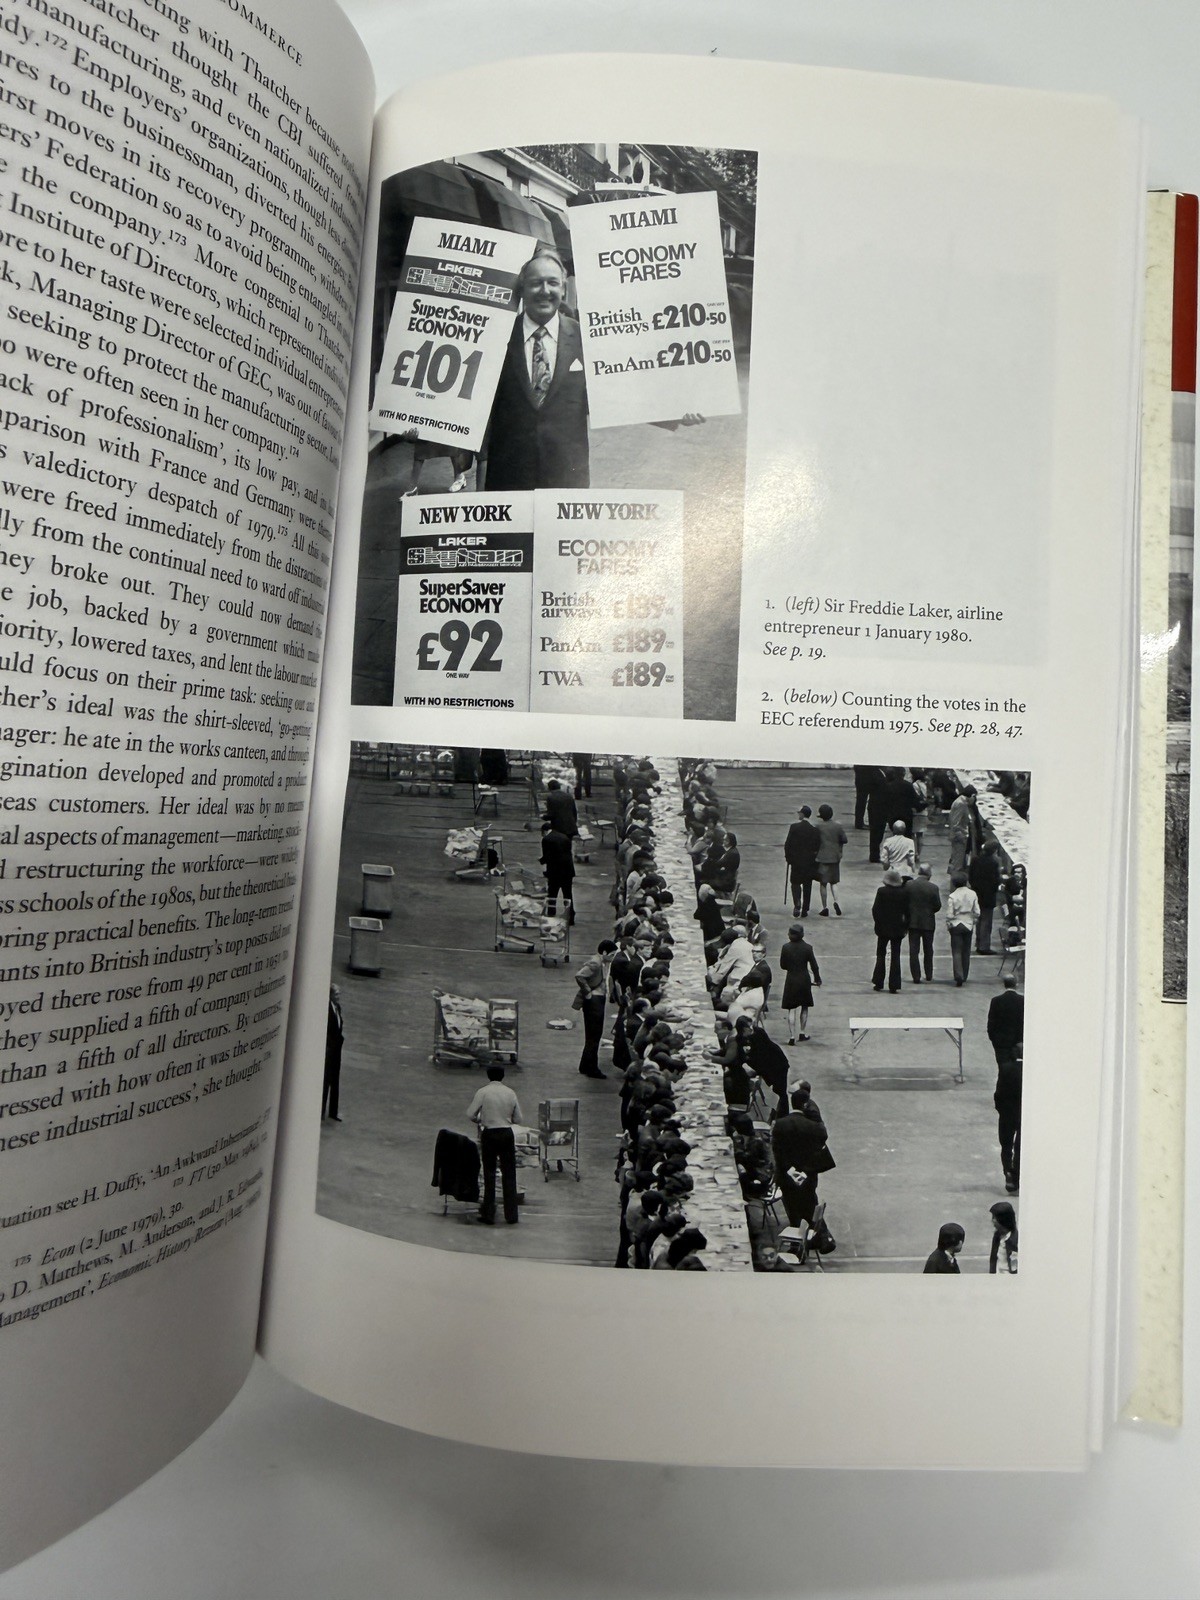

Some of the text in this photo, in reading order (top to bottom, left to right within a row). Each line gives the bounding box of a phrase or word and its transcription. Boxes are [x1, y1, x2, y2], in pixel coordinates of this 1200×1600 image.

[199, 26, 341, 157] with Thatcher because
[172, 41, 239, 96] thought
[248, 93, 269, 119] the
[278, 114, 302, 147] CBI
[308, 145, 343, 188] suffered
[191, 120, 290, 200] organizations,
[45, 108, 317, 283] moves in its recovery programme,
[45, 138, 297, 291] Federation so as to avoid being
[609, 208, 678, 230] MIAMI
[438, 233, 497, 257] MIAMI
[598, 243, 697, 268] ECONOMY
[9, 192, 324, 370] Institute of Directors, which represented
[437, 262, 483, 277] LAKER
[619, 262, 681, 283] FARES
[411, 299, 490, 327] SuperSaver
[587, 307, 642, 326] British
[407, 317, 484, 343] ECONOMY
[589, 321, 649, 338] airways
[28, 271, 312, 419] Managing Director of GEC, was out
[391, 340, 483, 400] £101
[379, 409, 470, 435] WITH NO RESTRICTIONS
[98, 437, 316, 531] with France and Germany were
[419, 505, 512, 524] NEW YORK
[557, 503, 659, 520] NEW YORK
[438, 537, 487, 546] LAKER
[51, 555, 282, 624] broke out. They could now
[419, 578, 506, 598] SuperSaver
[419, 598, 503, 614] ECONOMY
[765, 596, 1003, 620] 1. (left) Sir Freddie Laker, airline
[416, 620, 503, 671] £92
[612, 628, 666, 652] £189
[764, 621, 972, 644] entrepreneur 1 January 1980.
[71, 628, 299, 684] lowered taxes, and lent the labour
[763, 642, 826, 660] See p. 19.
[539, 671, 584, 686] TWA
[612, 662, 666, 686] £189
[428, 697, 441, 705] NO
[444, 698, 514, 707] RESTRICTIONS
[761, 688, 1026, 713] 2. (below) Counting the votes in the
[67, 696, 273, 737] ideal was the shirt-sleeved,
[760, 711, 1022, 738] EEC referendum 1975. See pp. 28, 47.
[98, 764, 274, 791] developed and promoted
[49, 796, 284, 818] customers. Her ideal was by no
[19, 879, 241, 913] schools of the 1980s, but the
[45, 957, 84, 979] into
[89, 952, 148, 973] British
[225, 937, 243, 956] top
[245, 931, 268, 952] posts
[71, 1042, 248, 1104] with how often it was the
[56, 1173, 146, 1213] see H. Duffy,
[42, 1203, 184, 1266] Econ (2 June 1979), 30.
[12, 1213, 195, 1299] D. Matthews, M. Anderson,
